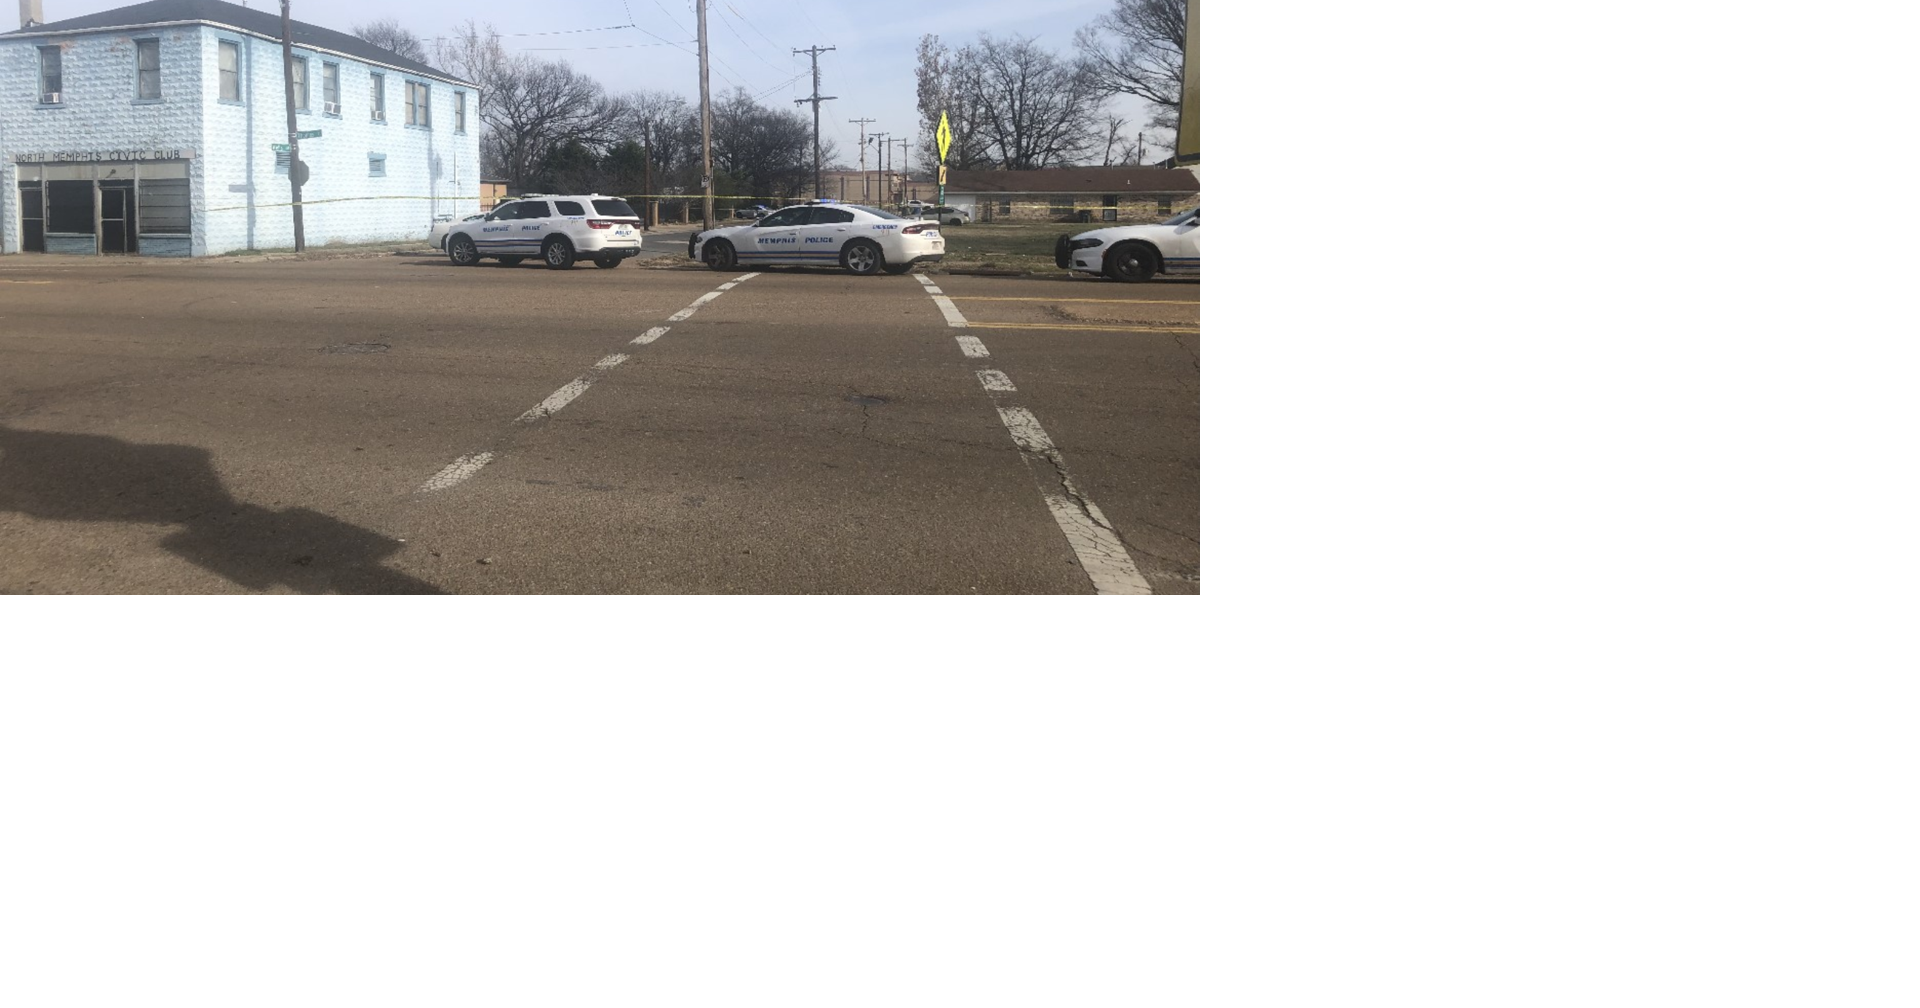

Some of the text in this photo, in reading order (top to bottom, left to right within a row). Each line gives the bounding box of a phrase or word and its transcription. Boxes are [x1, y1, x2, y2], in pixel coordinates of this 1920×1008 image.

[16, 150, 181, 163] NORTH MEMPHIS CIVIC CLUB
